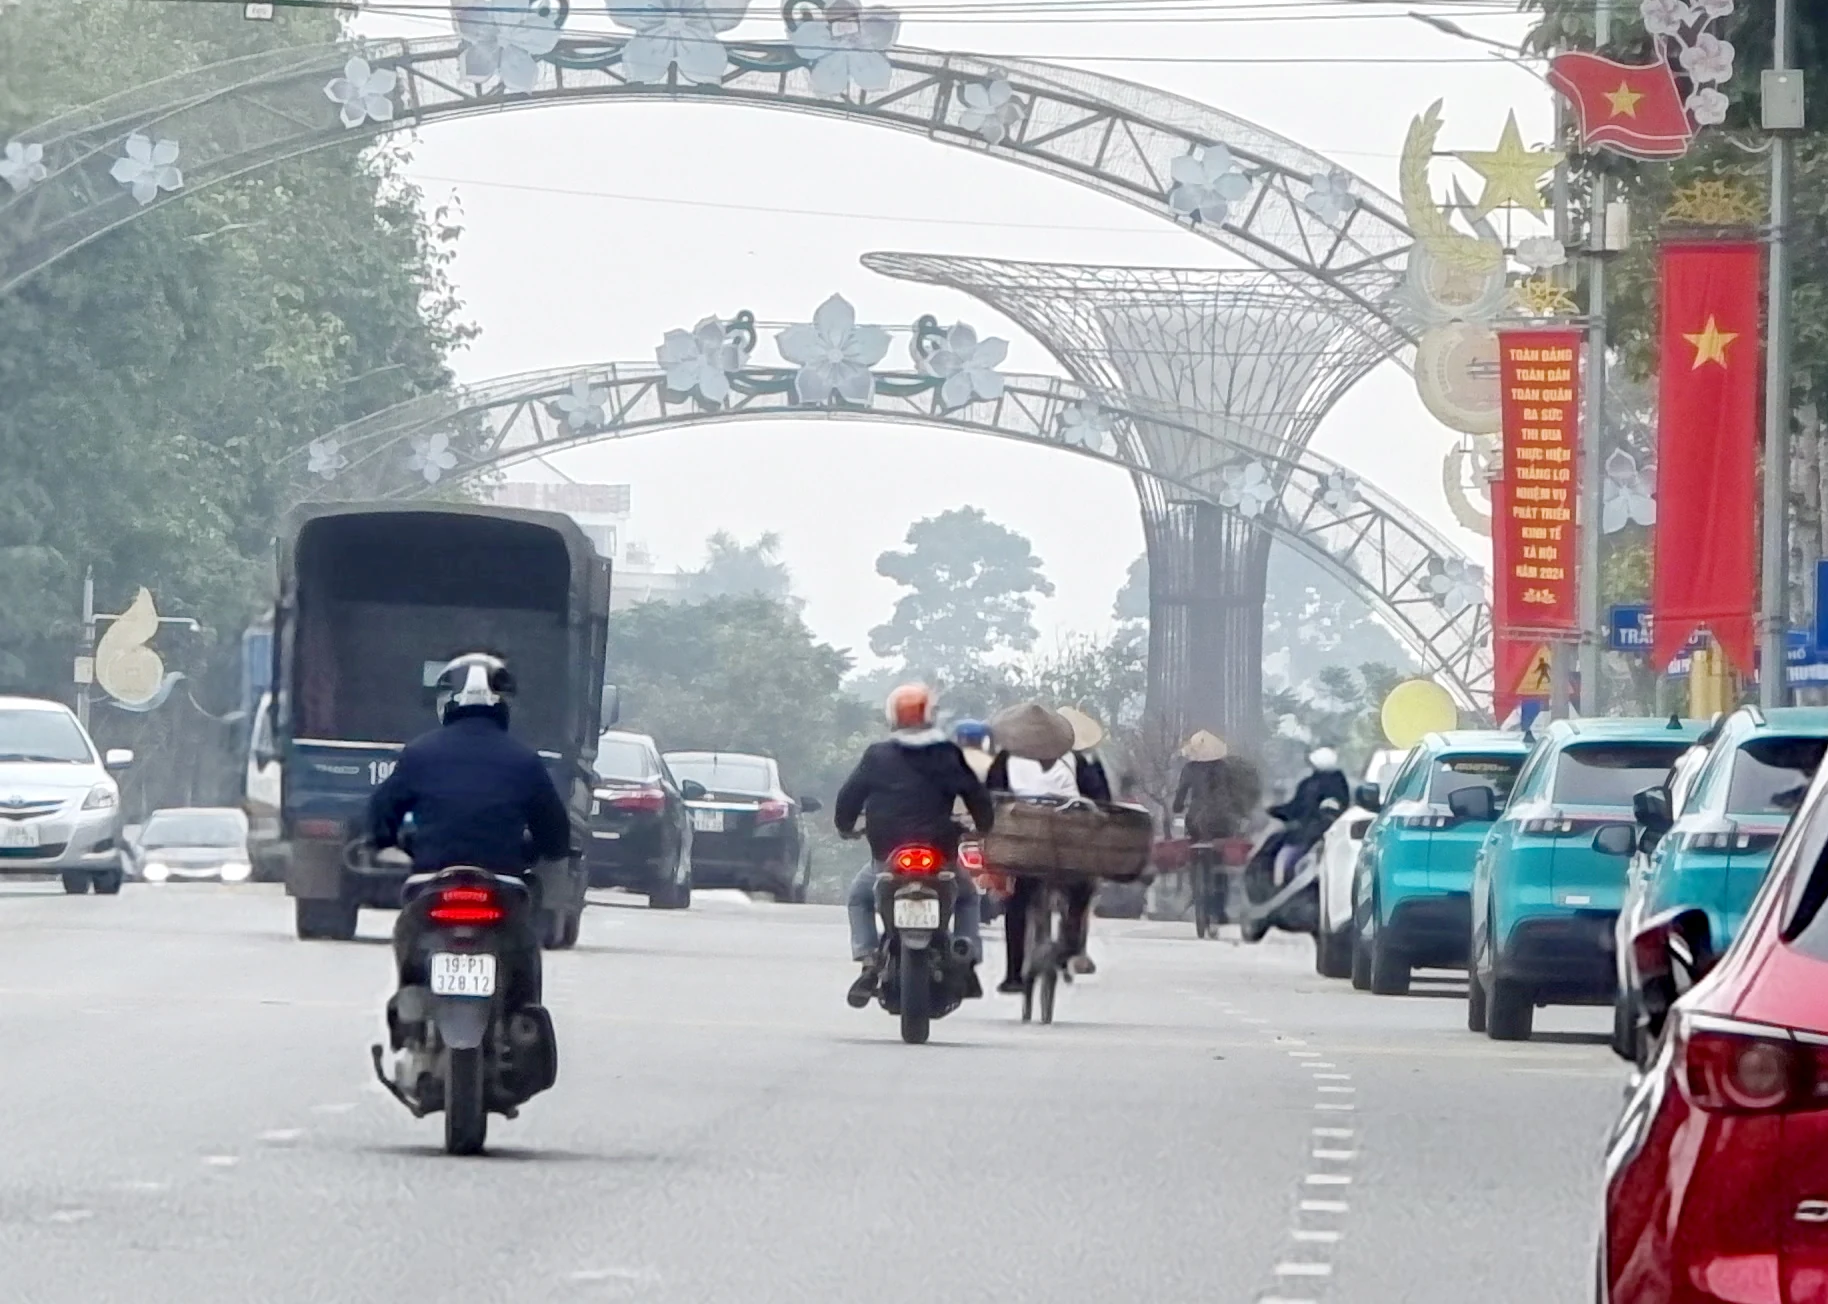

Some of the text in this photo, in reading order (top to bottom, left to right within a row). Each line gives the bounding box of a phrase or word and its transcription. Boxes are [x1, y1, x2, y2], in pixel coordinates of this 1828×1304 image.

[1509, 347, 1539, 362] TOÀN
[1516, 367, 1545, 381] TOÀN
[1511, 387, 1540, 401] TOÀN
[1523, 407, 1539, 421] RA
[1521, 427, 1539, 441] THI
